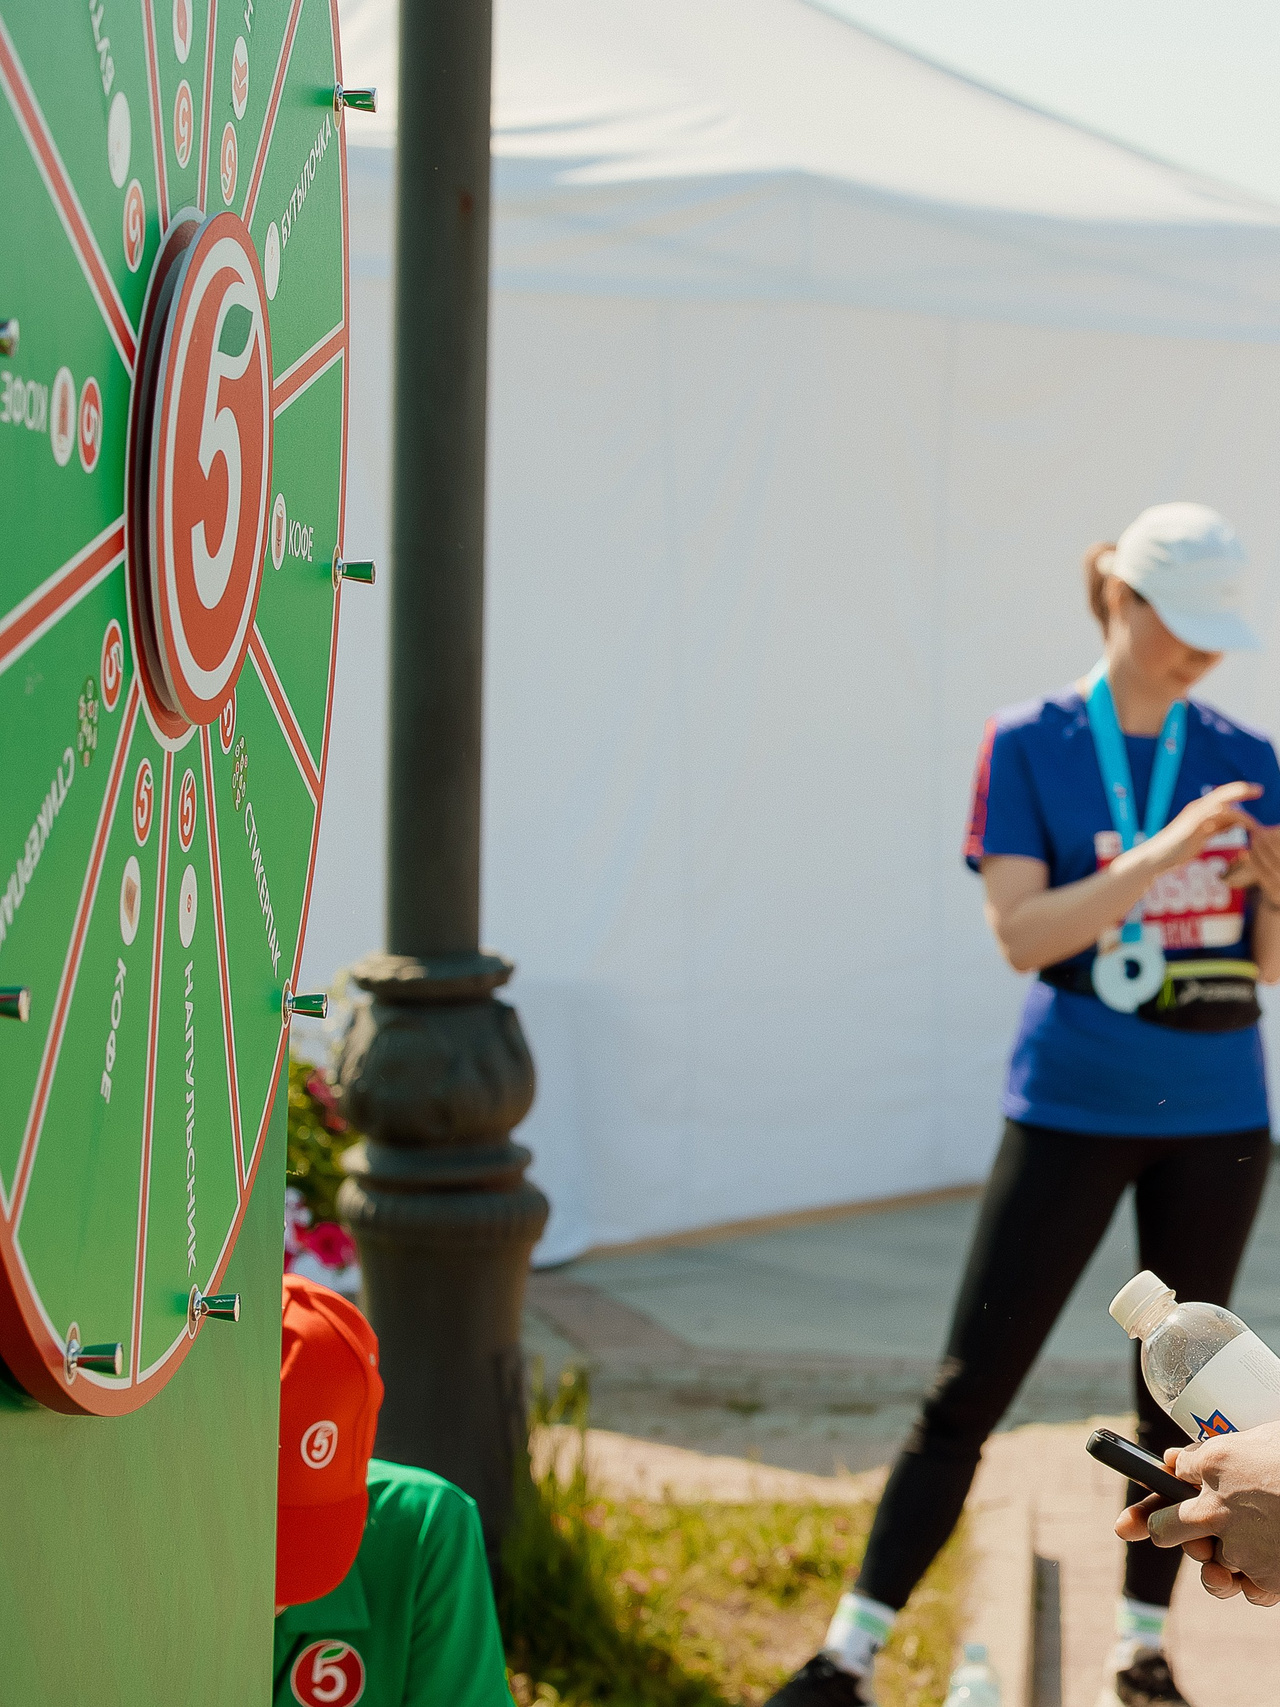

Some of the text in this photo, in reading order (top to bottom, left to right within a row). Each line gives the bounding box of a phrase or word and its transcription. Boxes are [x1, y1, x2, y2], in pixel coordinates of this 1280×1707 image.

[281, 112, 331, 249] БУТЫЛОЧКА
[288, 520, 314, 563] КОФЕ
[244, 802, 281, 979] СТИКЕРПАК
[100, 957, 127, 1105] КОФЕ
[184, 960, 198, 1278] НАПУЛЬСНИК
